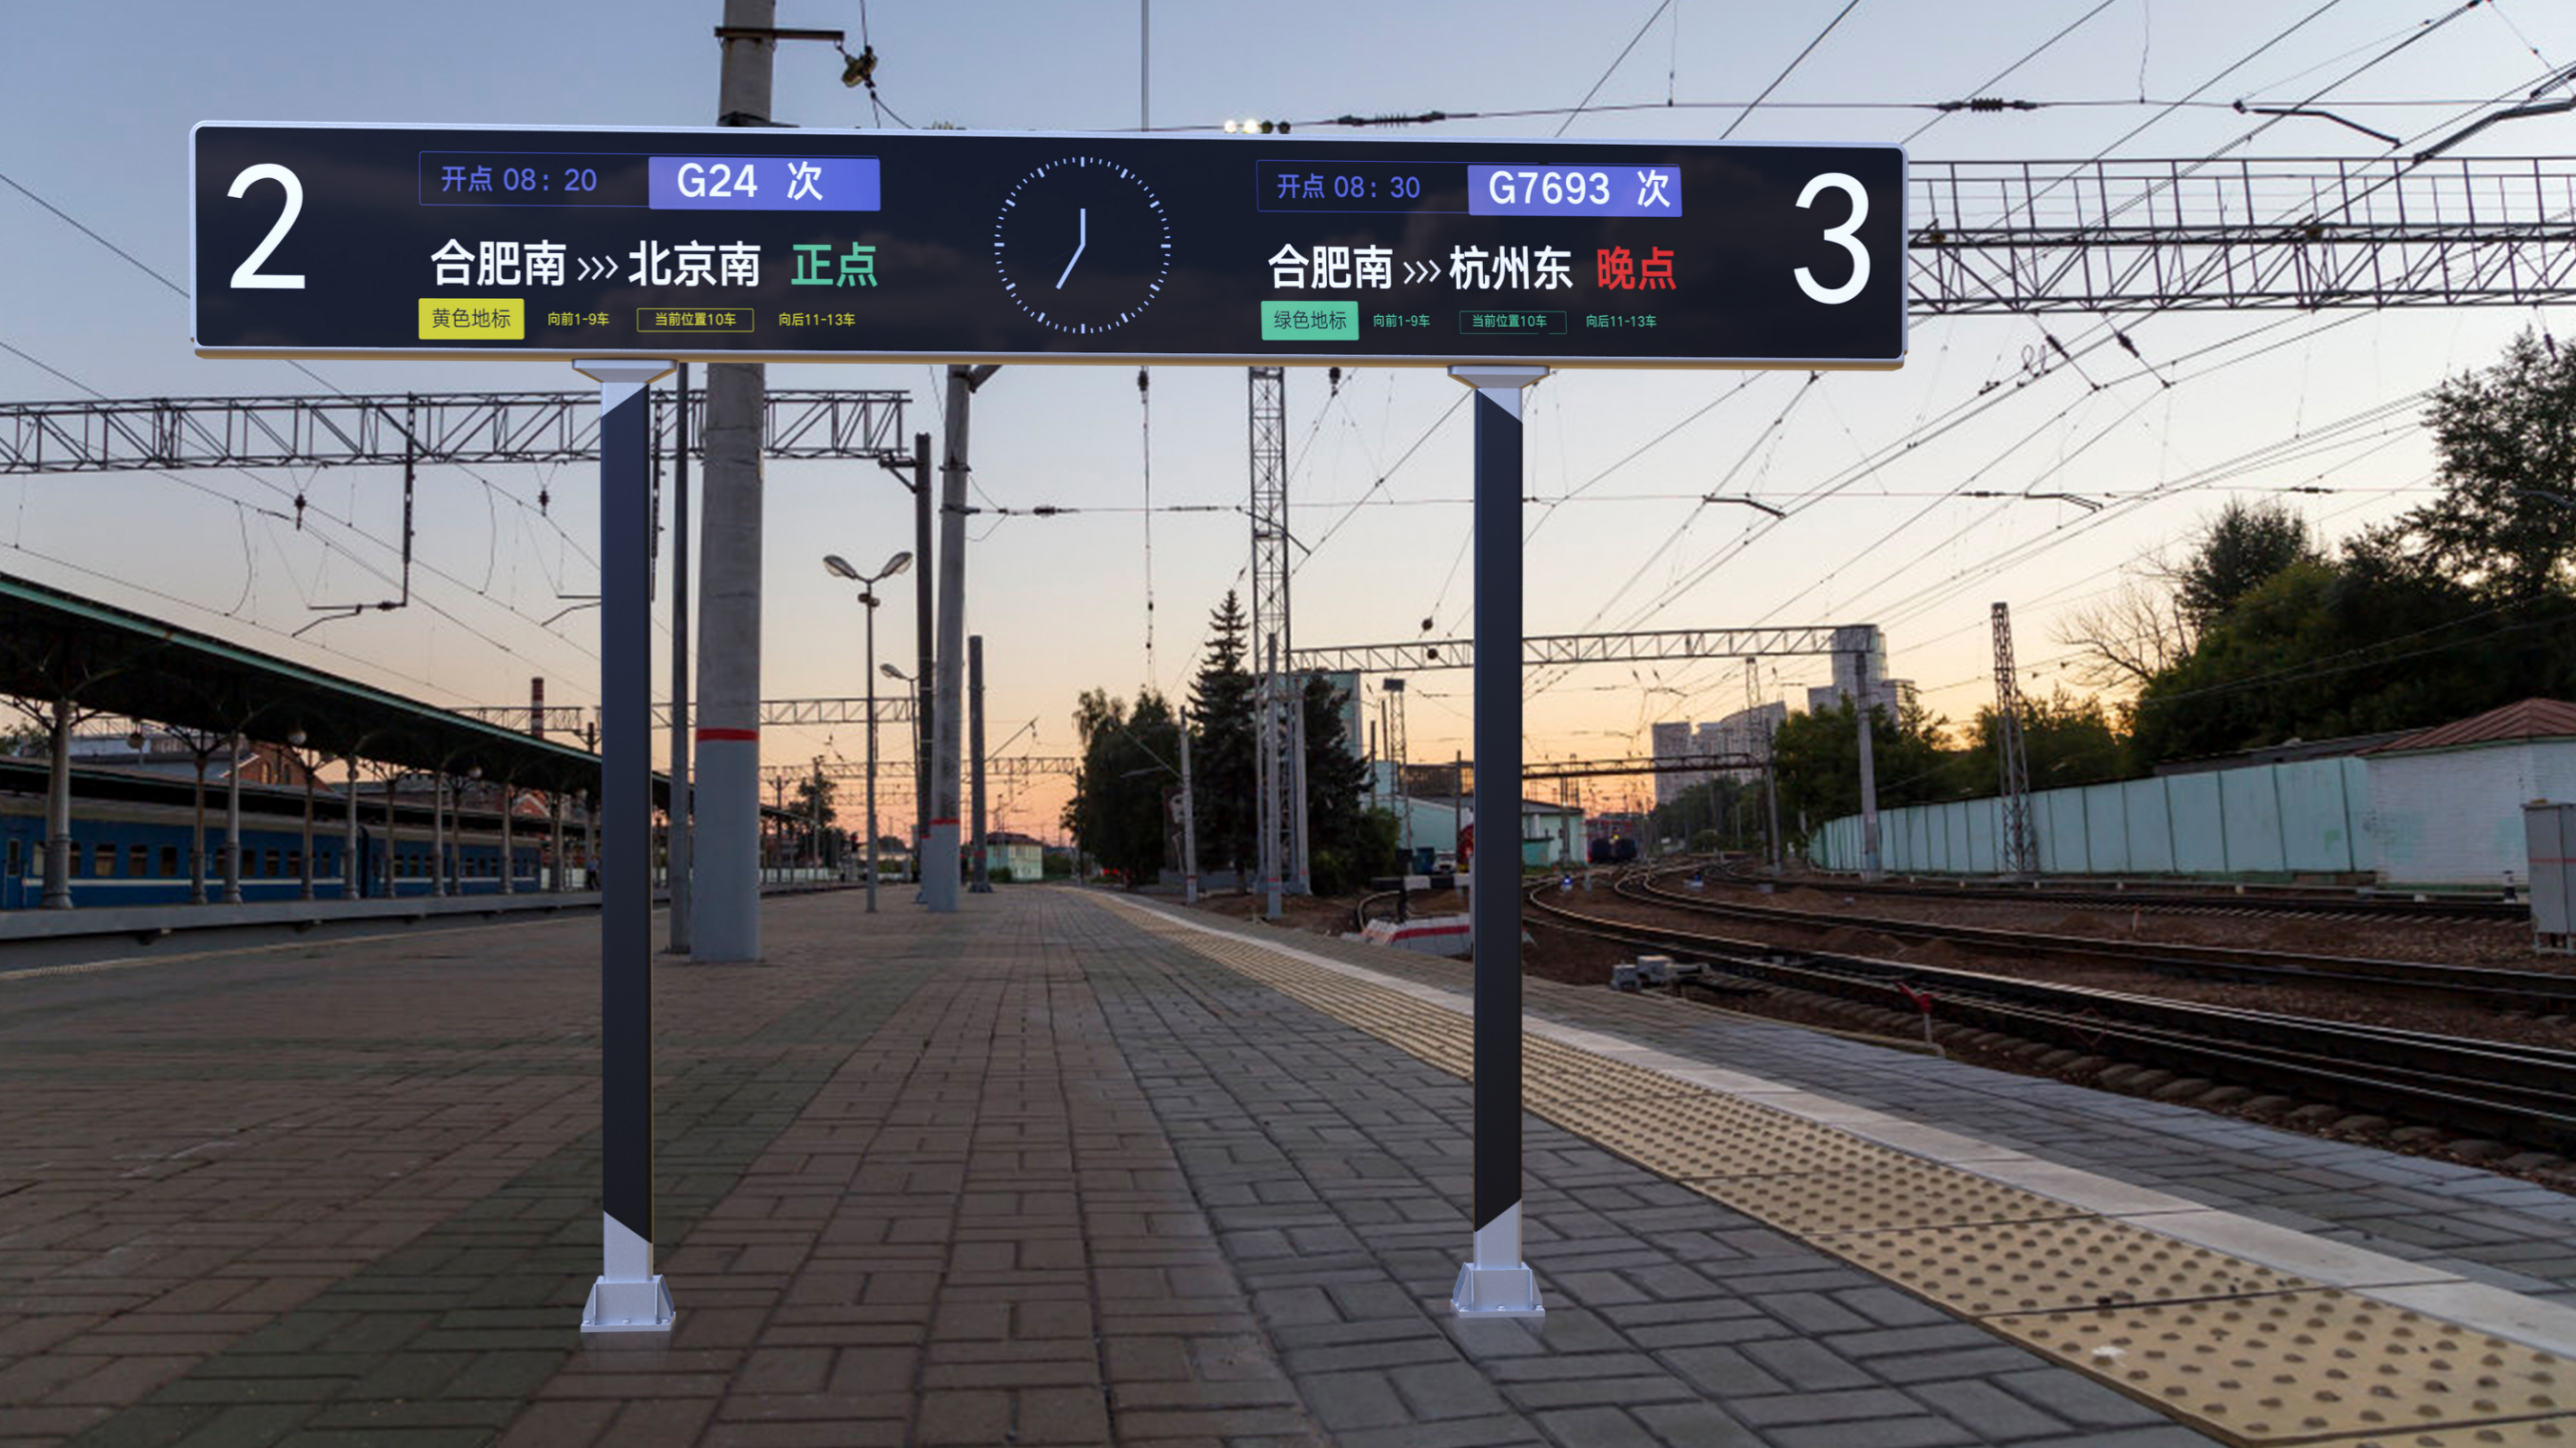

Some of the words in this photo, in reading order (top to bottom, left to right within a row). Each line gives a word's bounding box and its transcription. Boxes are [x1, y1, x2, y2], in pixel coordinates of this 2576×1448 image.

[442, 166, 492, 191] 开点
[678, 163, 758, 197] G24
[787, 161, 822, 198] 次
[1278, 173, 1324, 198] 开点
[1490, 170, 1610, 205] G7693
[1637, 171, 1671, 207] 次
[228, 164, 305, 288] 2
[1794, 172, 1870, 304] 3
[431, 239, 566, 286] 合肥南
[628, 240, 761, 287] 北京南
[791, 242, 878, 287] 正点
[1268, 244, 1393, 288] 合肥南
[1449, 246, 1573, 289] 杭州东
[1597, 246, 1676, 290] 晚点
[432, 308, 510, 328] 黄色地标
[548, 312, 609, 326] 向前1-9车
[656, 312, 736, 326] 当前位置10车
[780, 312, 855, 326] 向后11-13车
[1275, 310, 1346, 329] 绿色地标
[1374, 314, 1430, 327] 向前1-9车
[1473, 315, 1547, 327] 当前位置10车
[1587, 314, 1656, 327] 向后11-13车
